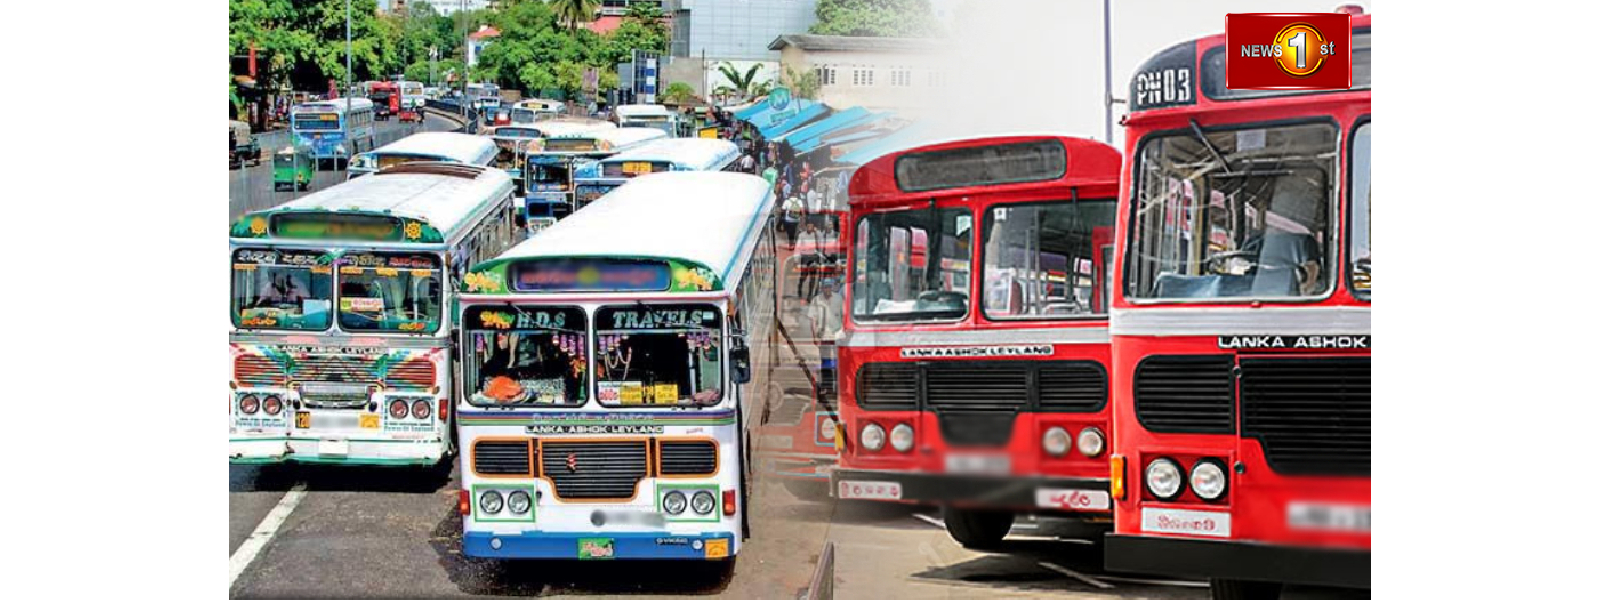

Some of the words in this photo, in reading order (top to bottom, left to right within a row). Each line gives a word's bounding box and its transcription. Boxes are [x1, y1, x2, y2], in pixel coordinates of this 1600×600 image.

[613, 311, 703, 329] TRAVELS
[1217, 335, 1285, 348] LANKA
[1293, 335, 1367, 348] ASHOK
[990, 345, 1051, 355] LEYLAND
[526, 426, 564, 434] LANKA
[570, 426, 608, 434] ASHOK
[611, 425, 663, 434] LEYLAND
